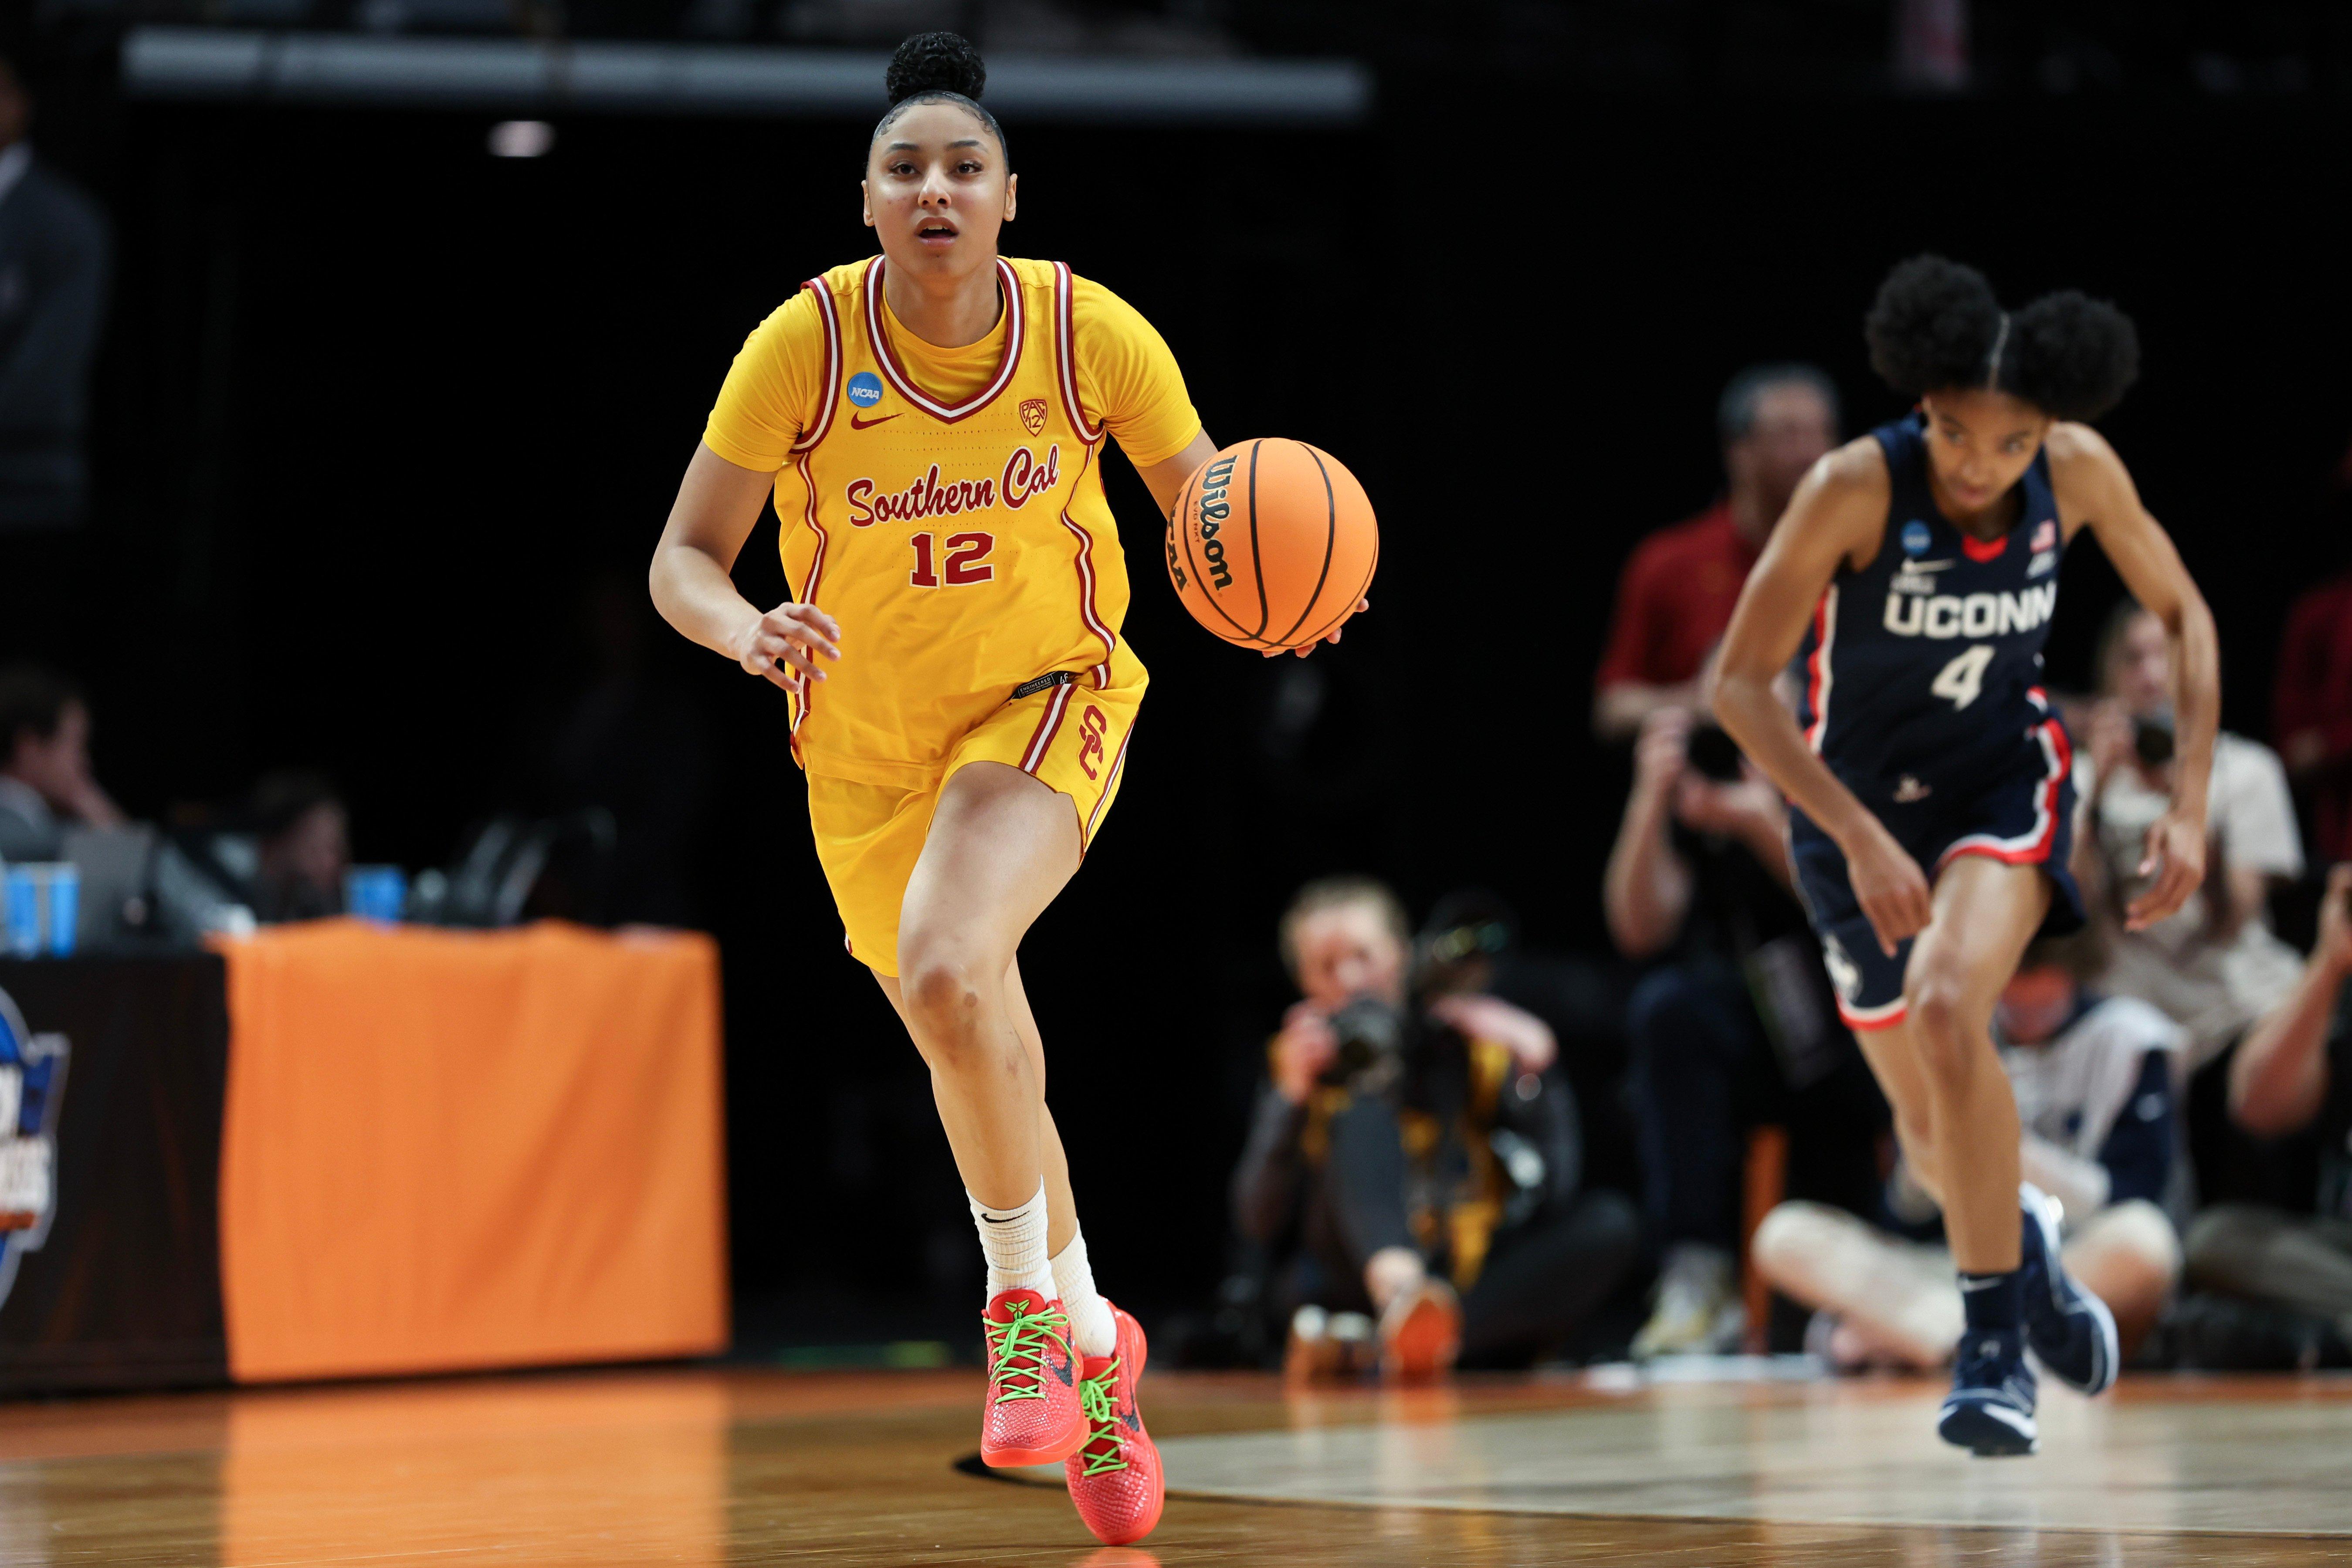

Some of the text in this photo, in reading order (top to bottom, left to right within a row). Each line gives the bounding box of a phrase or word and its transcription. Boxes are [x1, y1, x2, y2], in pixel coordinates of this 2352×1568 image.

[851, 387, 879, 399] NCAA
[1021, 401, 1045, 422] PAC
[1029, 415, 1041, 428] 12
[846, 444, 1060, 528] Southern Cal
[1199, 454, 1239, 591] Wilson
[909, 532, 996, 589] 12
[1883, 581, 2057, 639] UCONN
[1020, 677, 1051, 692] ENGINEERED
[1931, 644, 1995, 712] 4
